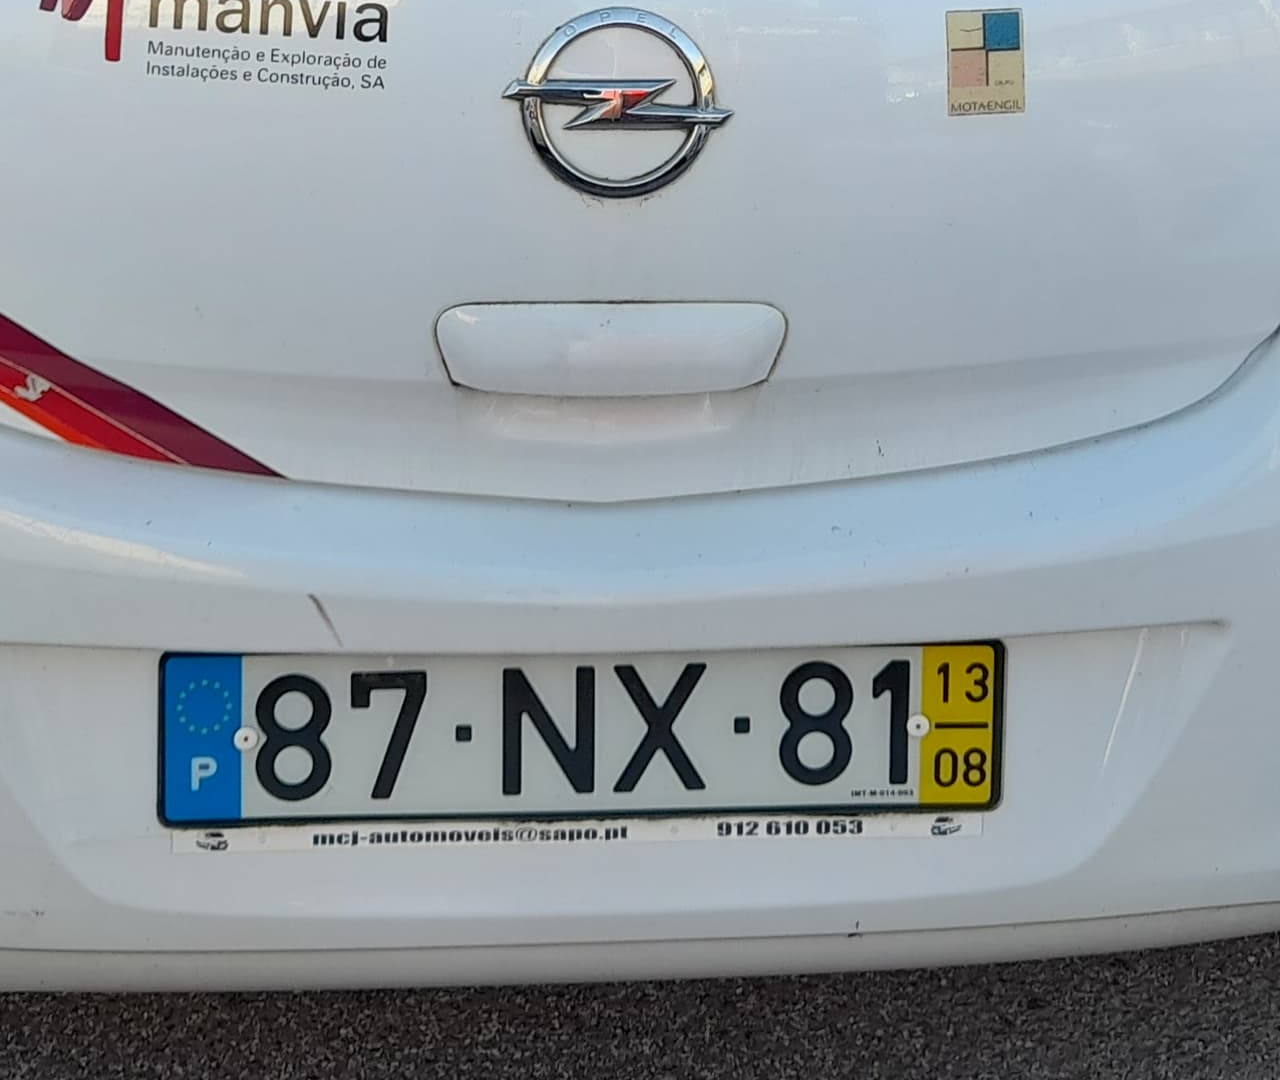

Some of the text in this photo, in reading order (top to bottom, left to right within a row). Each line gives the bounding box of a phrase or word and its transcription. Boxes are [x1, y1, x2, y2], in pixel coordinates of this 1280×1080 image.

[562, 11, 679, 39] OPEL
[147, 40, 387, 70] Manutenção e Exploração de
[146, 61, 386, 91] Instalações e Construção, SA
[935, 661, 991, 705] 13
[189, 756, 218, 792] P
[931, 746, 989, 789] 08
[717, 819, 864, 837] 912 610 053
